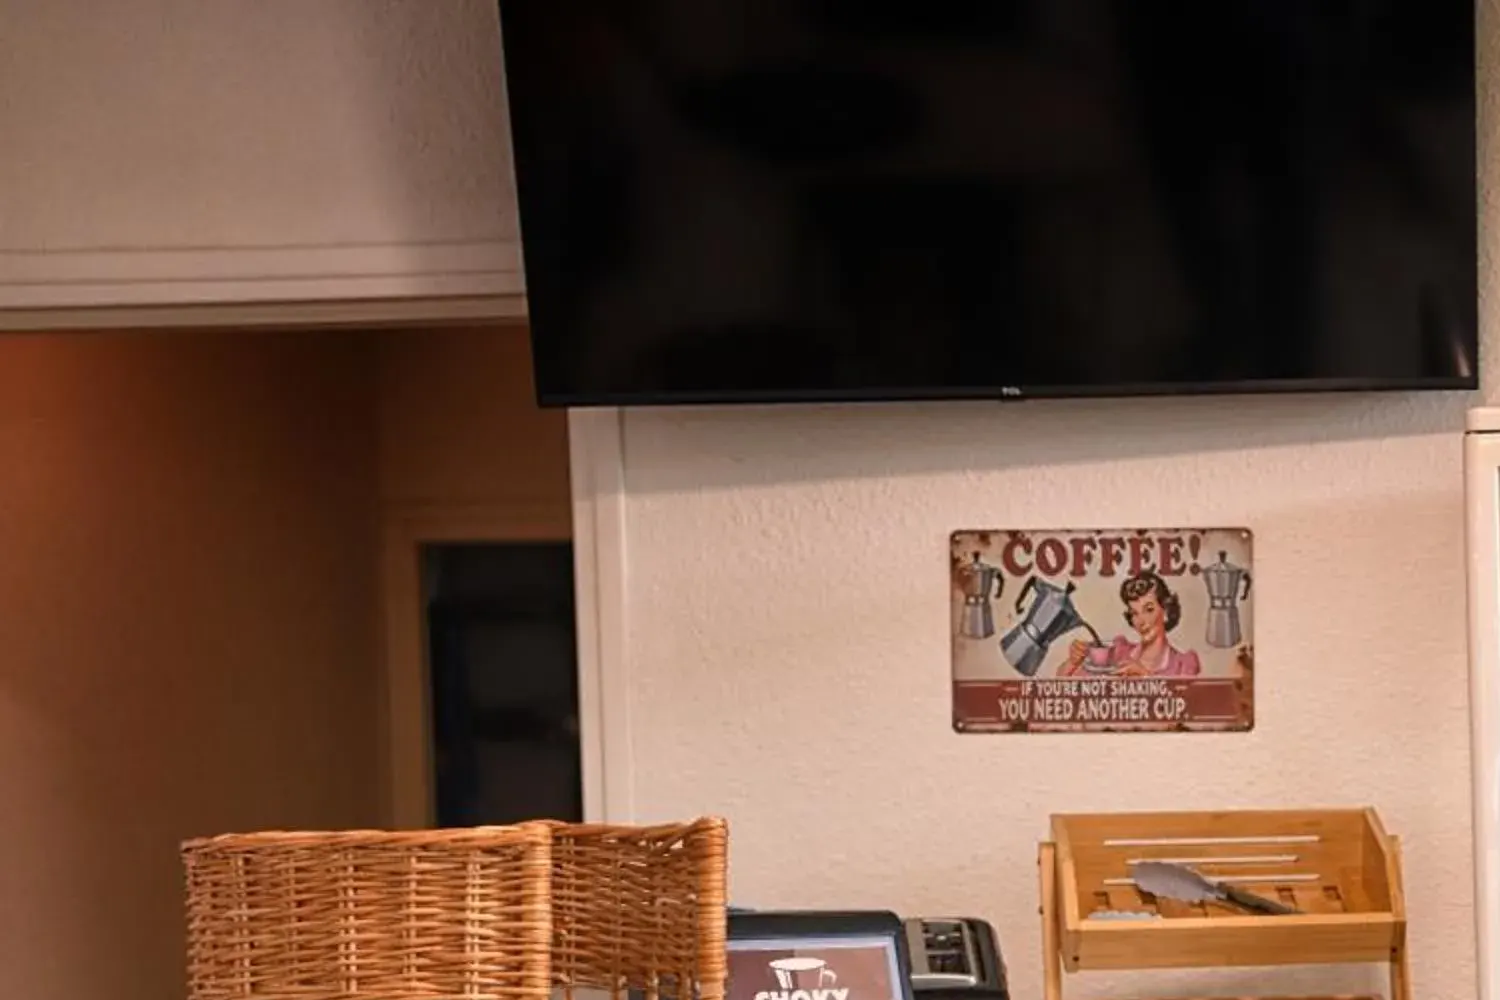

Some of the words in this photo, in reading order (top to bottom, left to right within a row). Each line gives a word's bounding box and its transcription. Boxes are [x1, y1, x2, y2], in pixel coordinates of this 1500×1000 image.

[1001, 534, 1202, 578] COFFEE!
[1021, 680, 1033, 697] IF
[1037, 680, 1079, 697] YOU'RE
[1080, 680, 1107, 697] NOT
[999, 698, 1030, 720] YOU
[1033, 698, 1074, 720] NEED
[1076, 697, 1150, 720] ANOTHER
